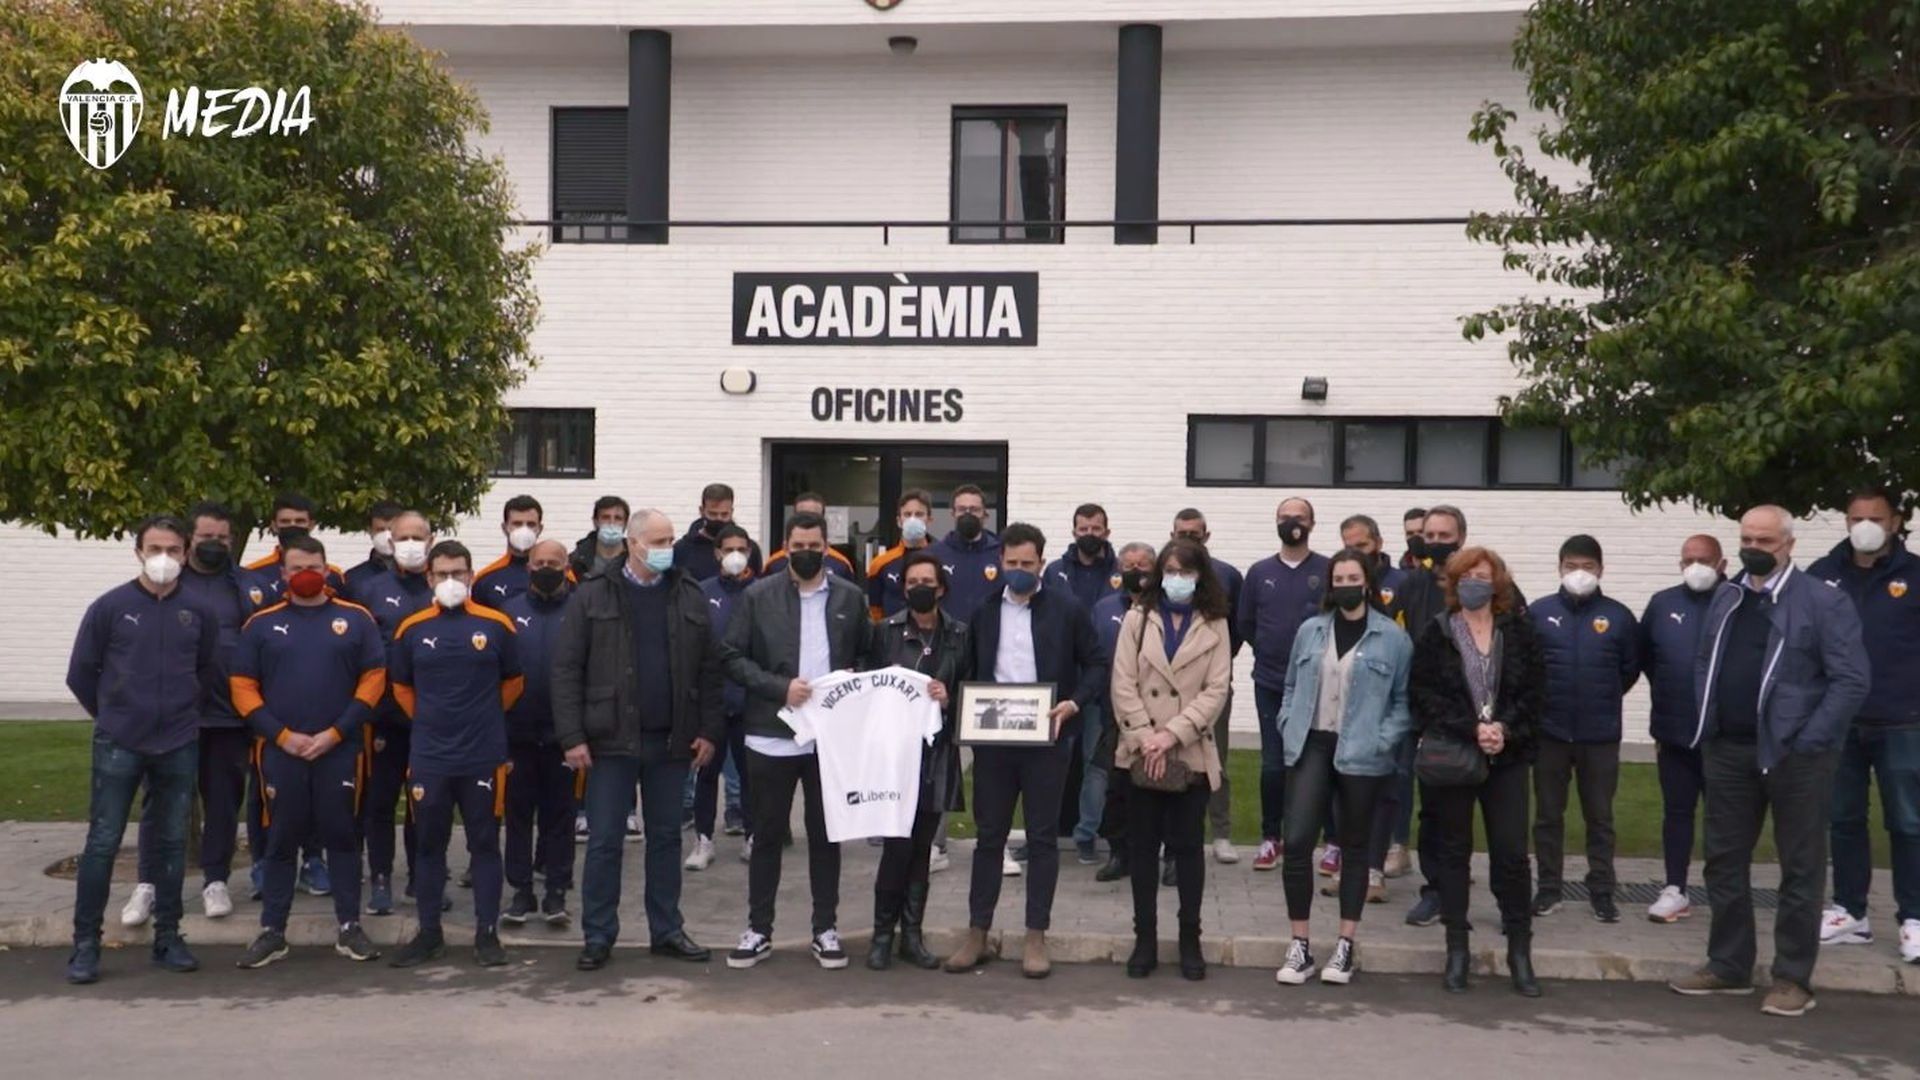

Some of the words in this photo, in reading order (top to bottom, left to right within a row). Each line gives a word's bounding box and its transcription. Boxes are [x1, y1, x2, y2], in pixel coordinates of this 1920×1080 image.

[745, 272, 1023, 338] ACADÈMIA
[811, 387, 964, 422] OFICINES
[821, 677, 863, 710] VICENÇ
[871, 674, 922, 703] CUXART
